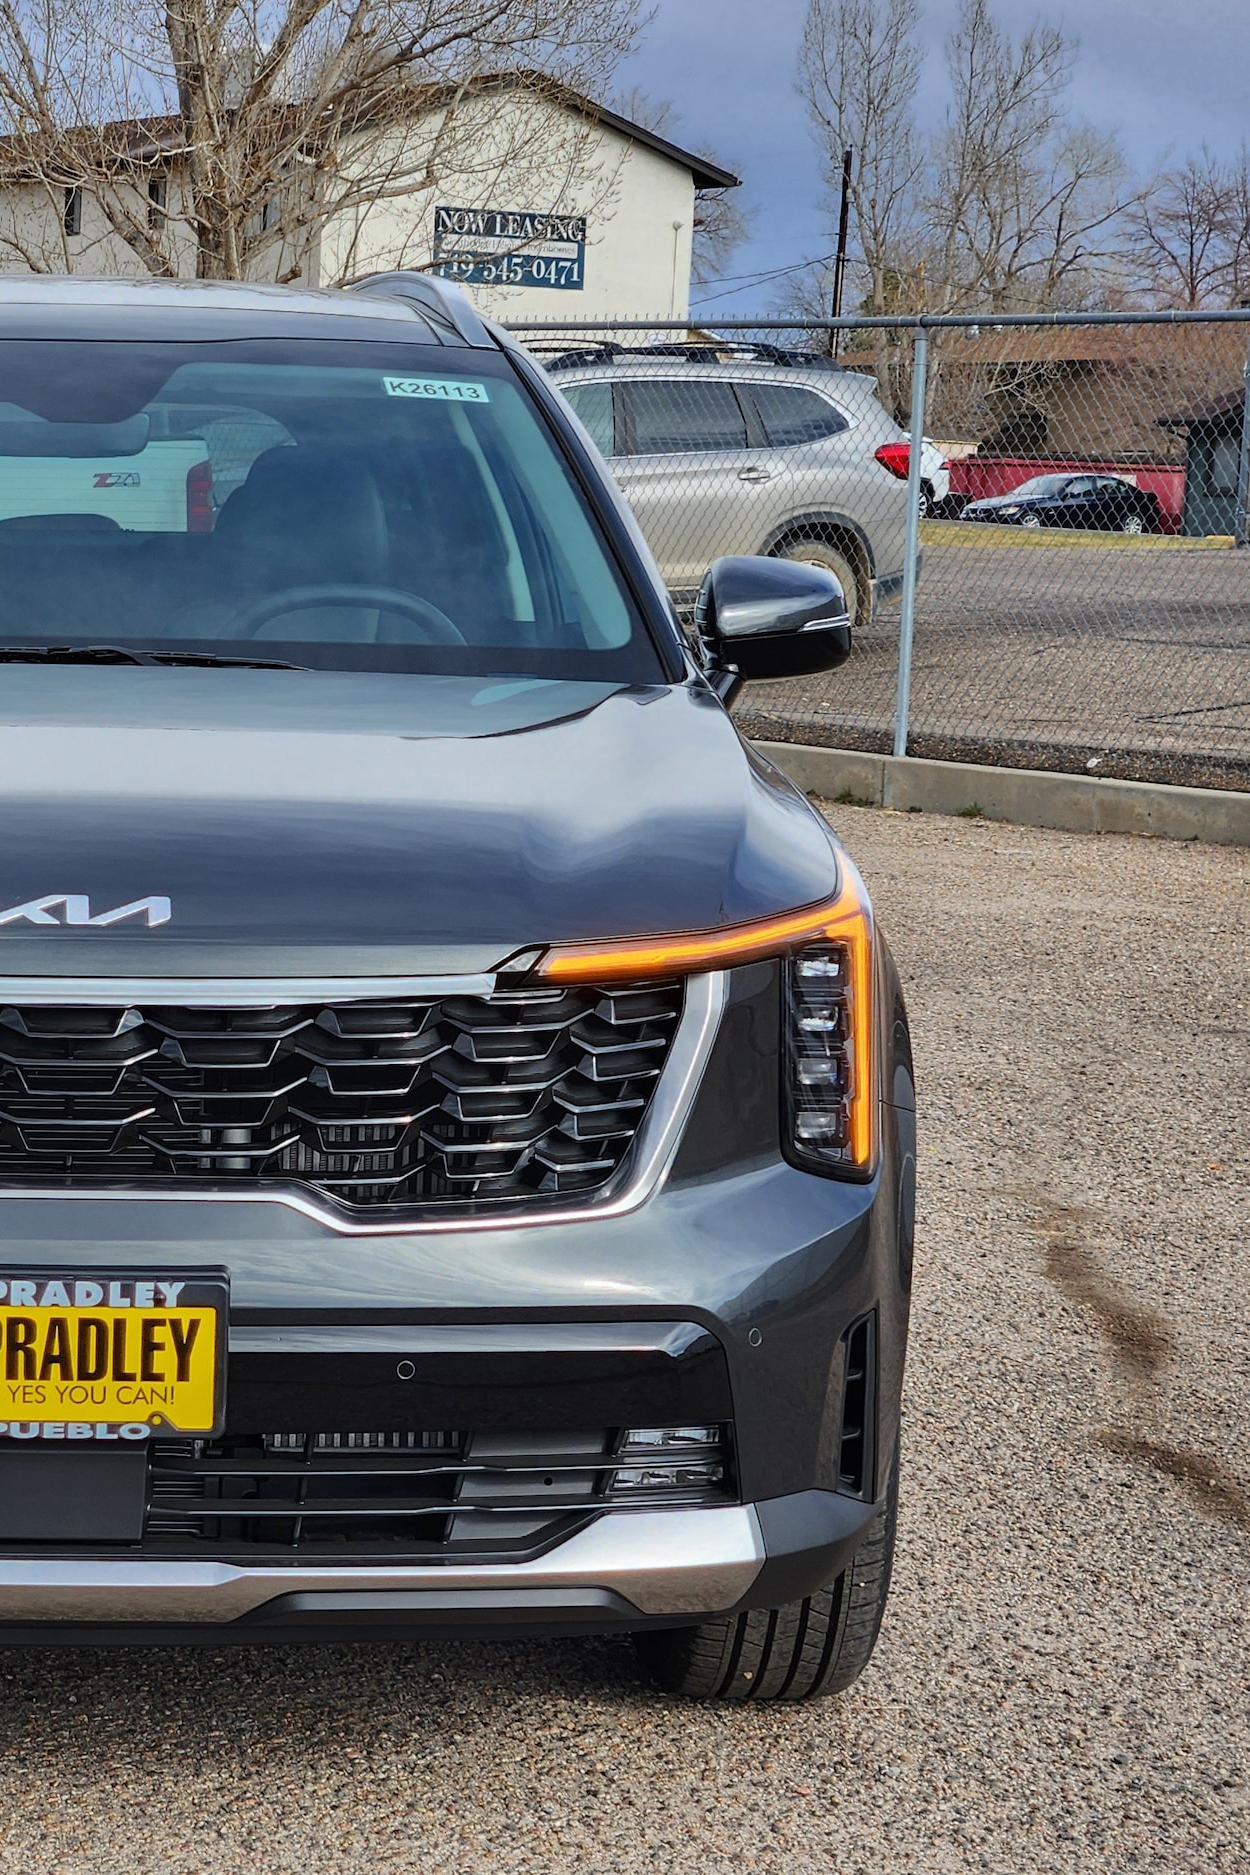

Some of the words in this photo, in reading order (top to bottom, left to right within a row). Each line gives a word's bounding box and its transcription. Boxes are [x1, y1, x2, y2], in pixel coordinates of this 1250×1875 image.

[437, 209, 488, 234] NOW
[494, 214, 584, 242] LEASING
[389, 381, 480, 399] K26113
[93, 472, 140, 488] Z71
[7, 1385, 46, 1405] YES
[54, 1385, 107, 1405] YOU
[116, 1386, 175, 1406] CAN!
